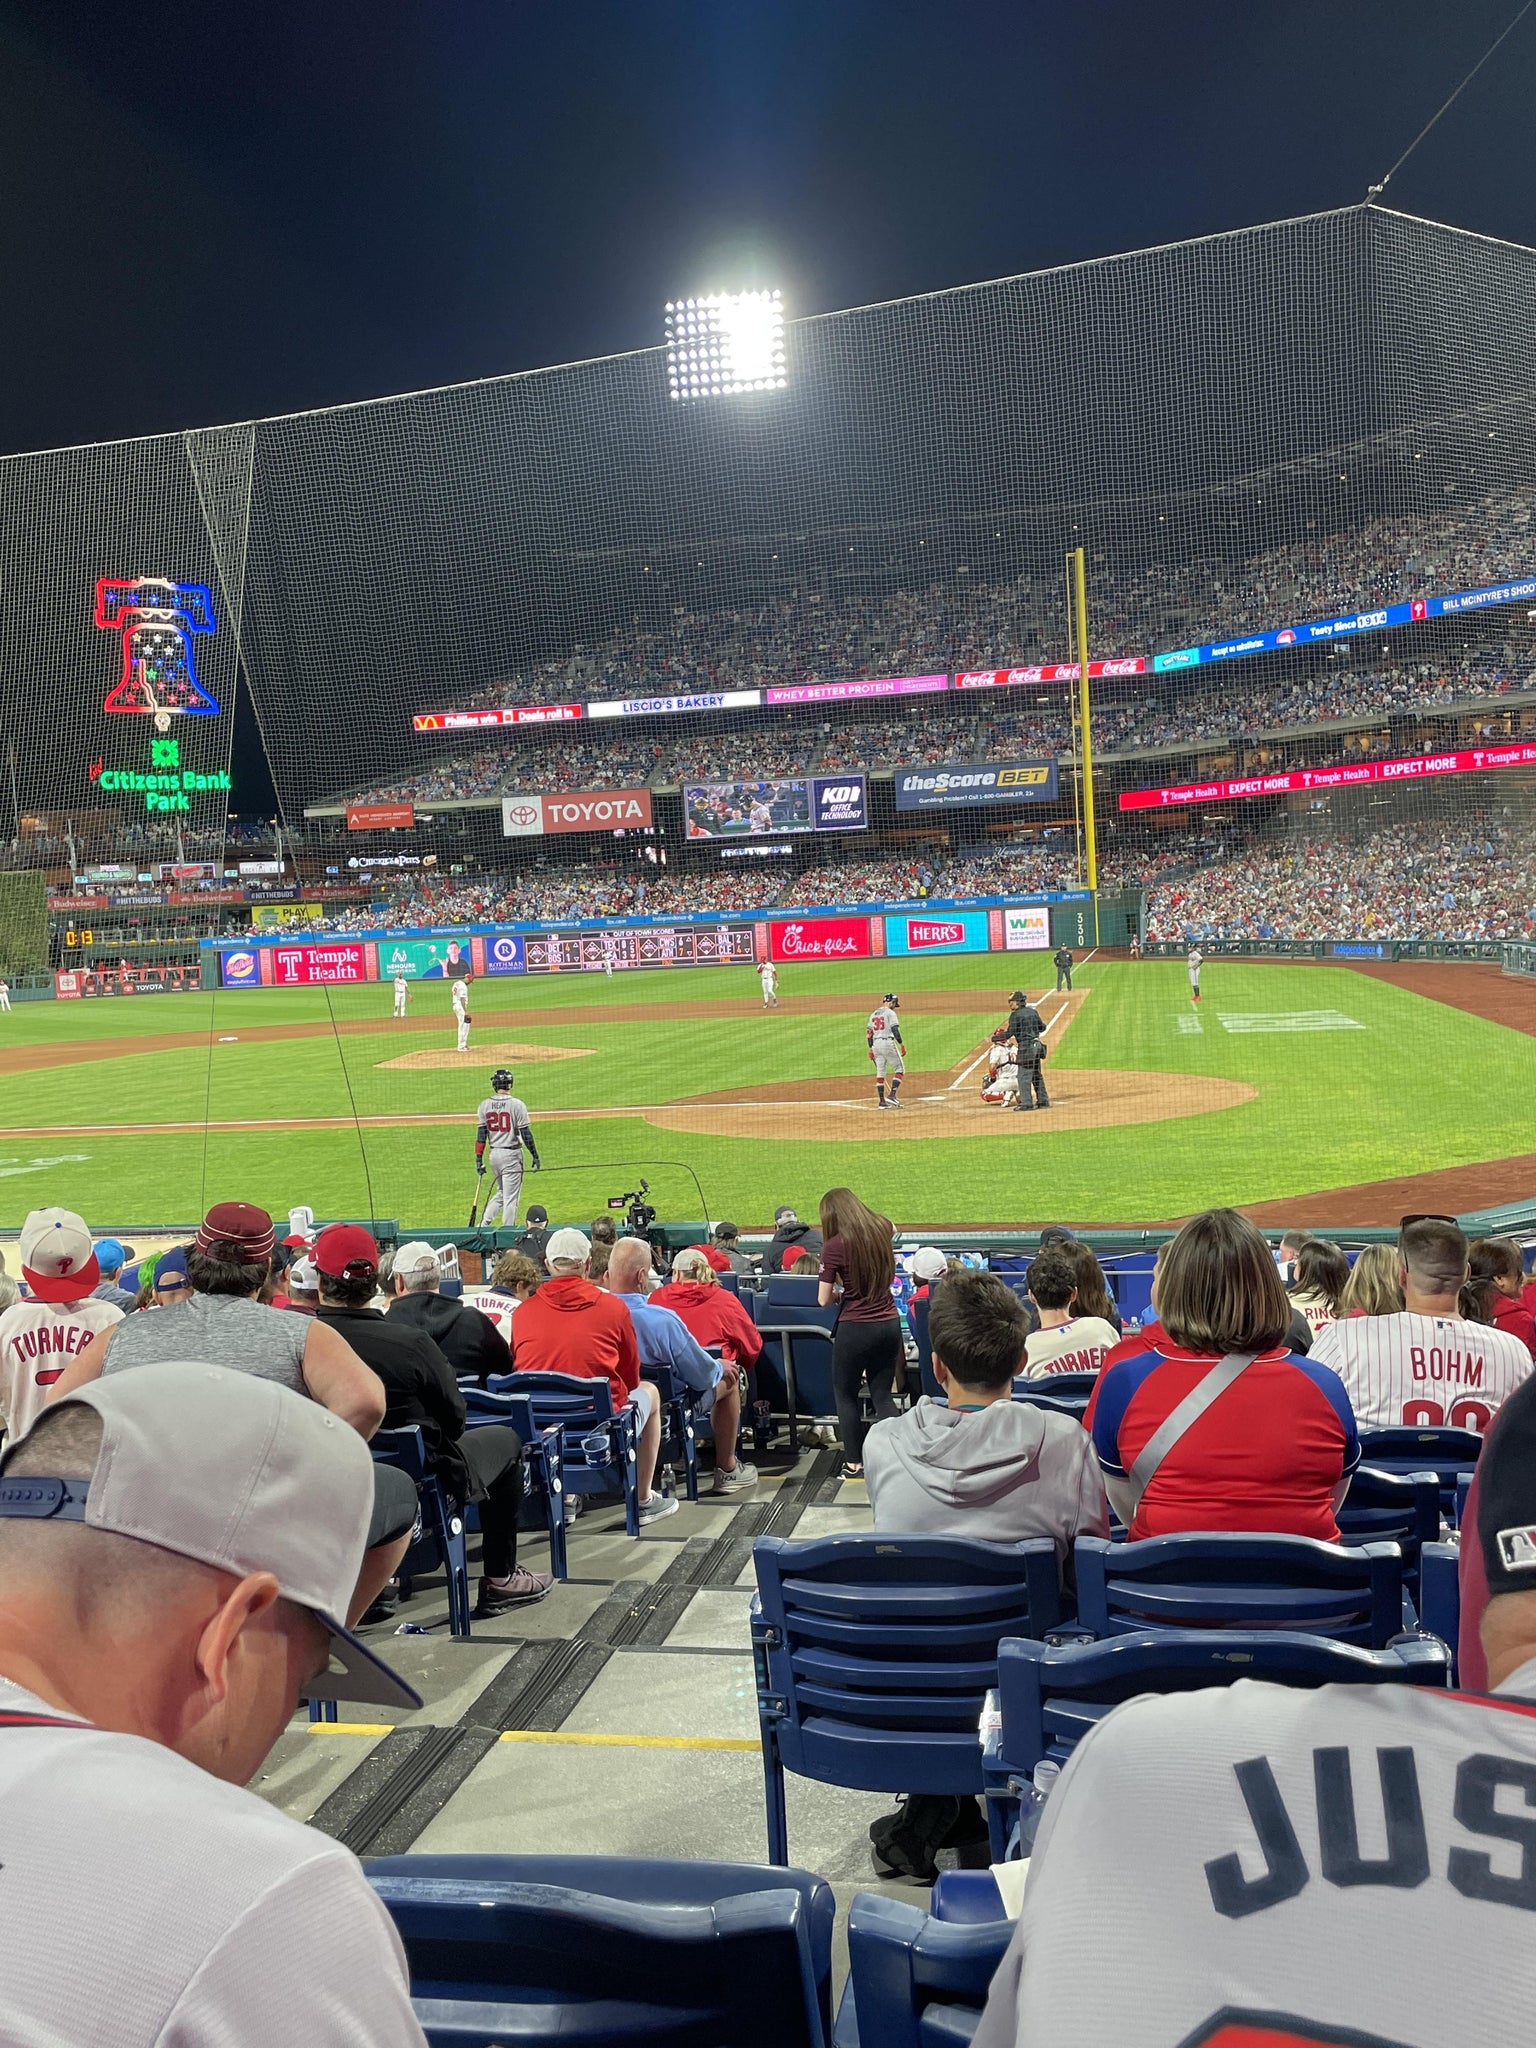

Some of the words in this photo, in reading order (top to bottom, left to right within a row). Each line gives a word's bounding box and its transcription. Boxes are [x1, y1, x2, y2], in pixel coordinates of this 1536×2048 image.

[1443, 600, 1460, 610] BILL
[1511, 583, 1536, 597] SHOO
[1310, 625, 1333, 636] Tasty
[1333, 620, 1357, 631] Since
[1358, 612, 1386, 627] 1914
[1102, 660, 1138, 675] Coca-Cola
[962, 672, 996, 687] Coca-Cola
[1008, 668, 1043, 683] Coca-Cola
[773, 690, 804, 700] WHEY
[807, 687, 846, 698] BETTER
[848, 682, 894, 695] PROTEIN
[623, 700, 672, 712] LISCIO'S
[677, 696, 724, 708] BAKERY
[444, 716, 478, 727] Phillies
[480, 715, 498, 724] win
[518, 711, 545, 721] Deals
[547, 709, 562, 719] roll
[563, 708, 573, 718] in
[1486, 750, 1520, 763] Temple
[1313, 772, 1342, 785] Temple
[1343, 768, 1370, 780] Health
[1383, 761, 1423, 777] EXPECT
[1425, 757, 1457, 771] MORE
[100, 770, 180, 790] Citizens
[182, 770, 231, 789] Bank
[902, 772, 996, 791] theScore
[1001, 769, 1044, 784] BET
[821, 786, 861, 804] KDI
[1170, 788, 1194, 801] Temple
[1195, 786, 1218, 798] Health
[1229, 781, 1262, 794] EXPECT
[1263, 777, 1290, 791] MORE
[146, 790, 189, 810] Park
[830, 803, 852, 812] OFFICE
[548, 799, 643, 824] TOYOTA
[821, 810, 861, 820] TECHNOLOGY
[53, 900, 97, 908] Budweiser
[283, 908, 307, 917] PLAY
[1009, 918, 1044, 929] WM
[718, 934, 731, 944] BAL
[736, 934, 741, 943] 2
[912, 925, 958, 941] HERR'S
[547, 943, 560, 952] DET
[565, 943, 570, 952] 4
[603, 941, 616, 950] TEX
[660, 937, 675, 947] CWS
[678, 937, 683, 946] 6
[782, 930, 858, 955] Chick-fil-A
[1333, 943, 1375, 955] Independence
[307, 948, 359, 966] Temple
[622, 951, 627, 959] 3
[661, 948, 673, 957] ATH
[679, 947, 683, 956] 7
[719, 946, 731, 955] CLE
[547, 954, 562, 963] BOS
[566, 954, 570, 962] 1
[308, 965, 357, 980] Health
[136, 983, 164, 991] TOYOTA
[486, 1111, 511, 1132] 20
[11, 1325, 94, 1363] TURNER
[1410, 1347, 1483, 1388] BOHM
